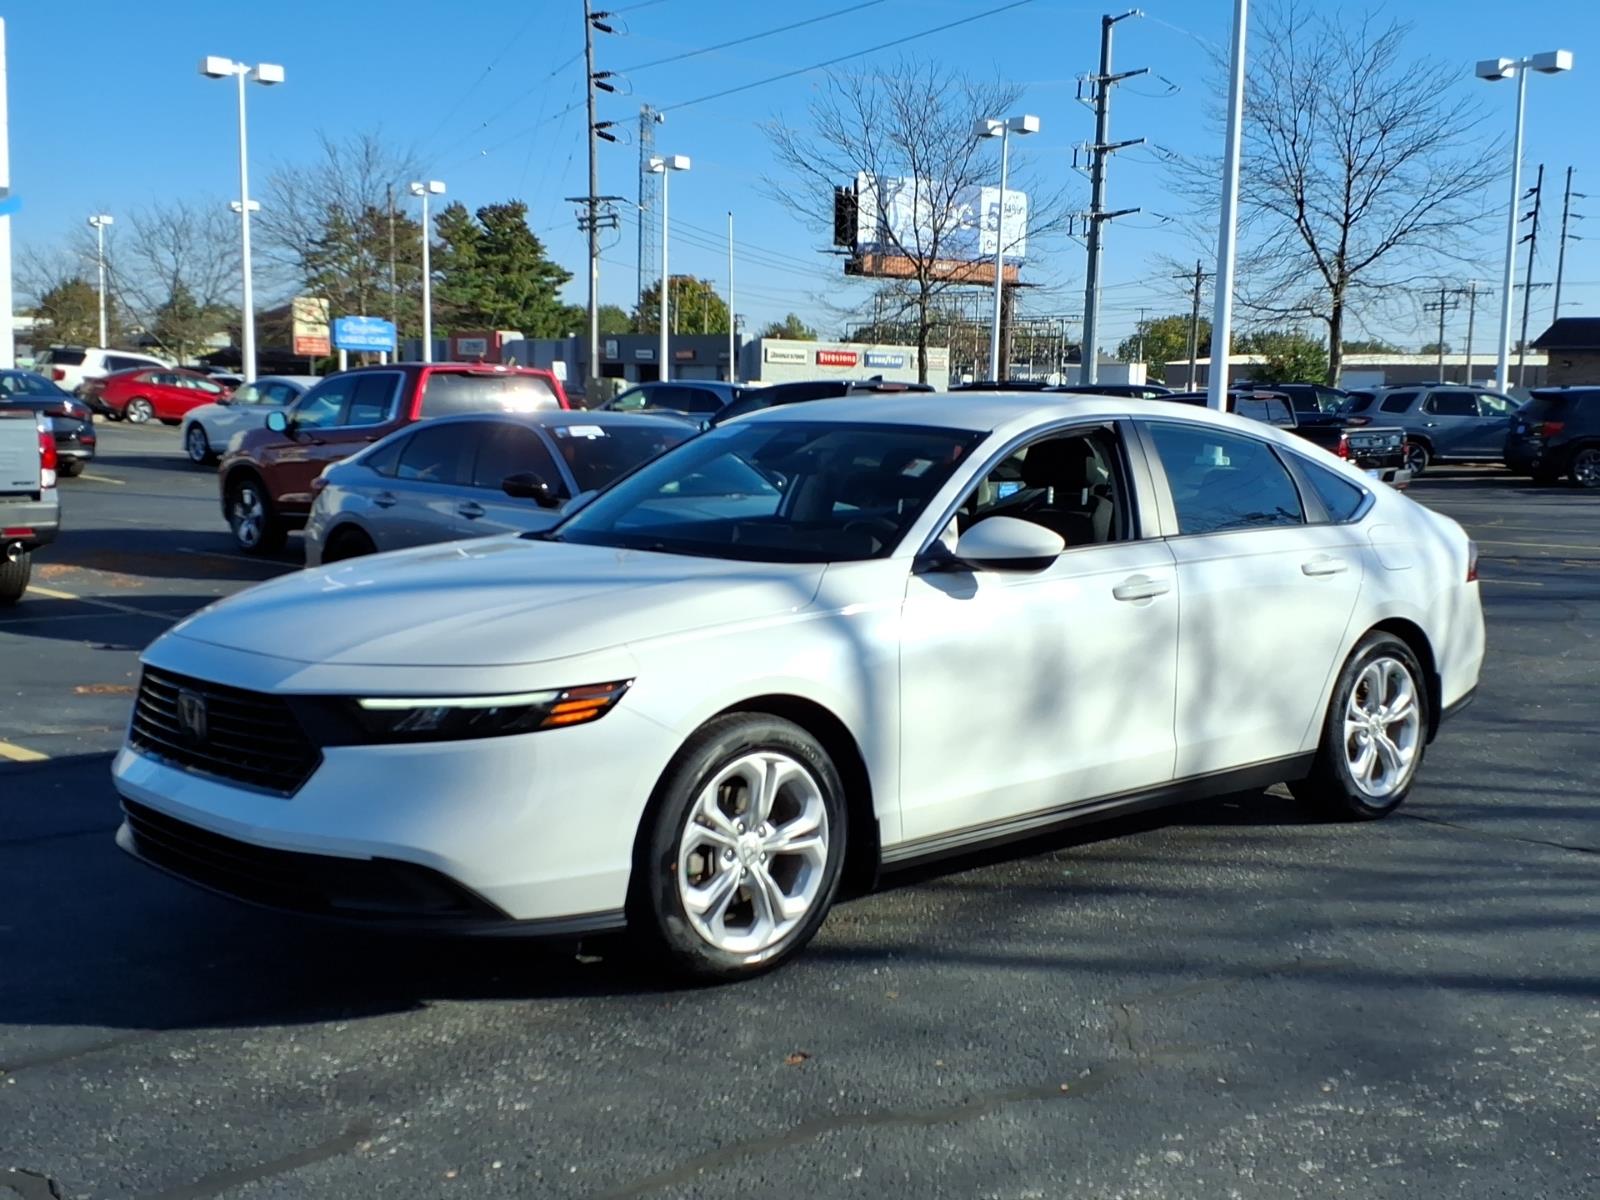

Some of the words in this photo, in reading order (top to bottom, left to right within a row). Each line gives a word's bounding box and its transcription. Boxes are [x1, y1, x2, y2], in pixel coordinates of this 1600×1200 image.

[340, 335, 366, 344] USED
[368, 336, 391, 346] CARS
[819, 352, 856, 363] Firestone
